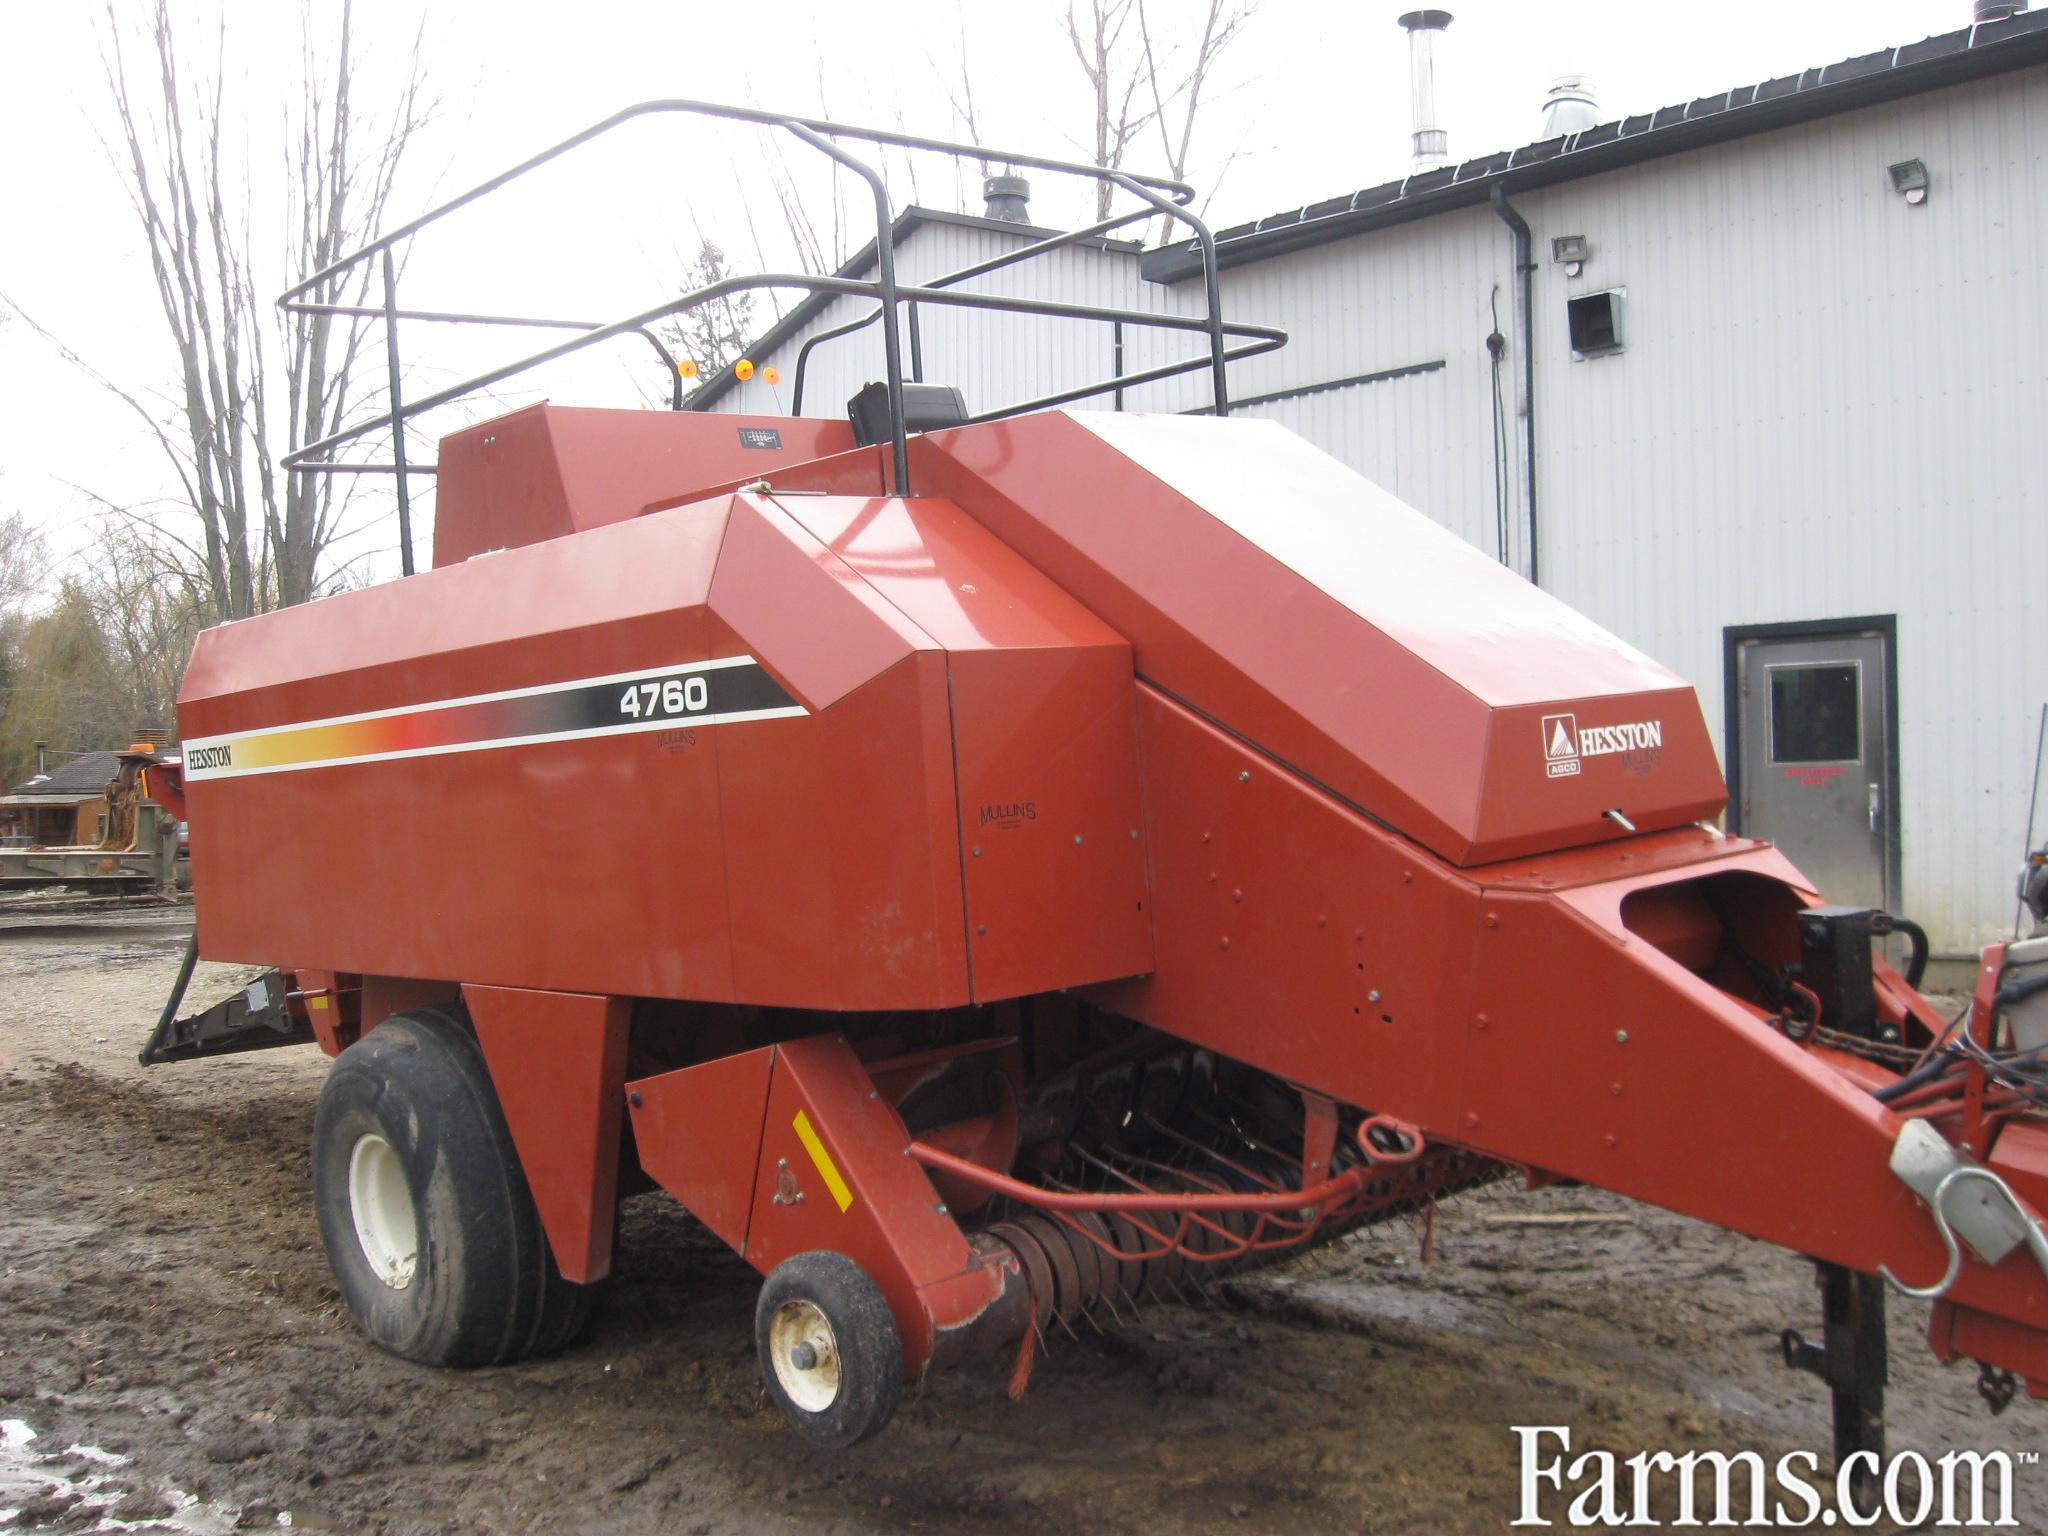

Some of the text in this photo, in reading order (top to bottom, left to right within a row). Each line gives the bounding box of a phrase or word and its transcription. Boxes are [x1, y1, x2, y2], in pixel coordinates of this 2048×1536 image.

[620, 677, 708, 718] 4760
[1579, 720, 1663, 757] HESSTON
[188, 744, 232, 770] HESSTON
[1551, 763, 1577, 775] AGCO
